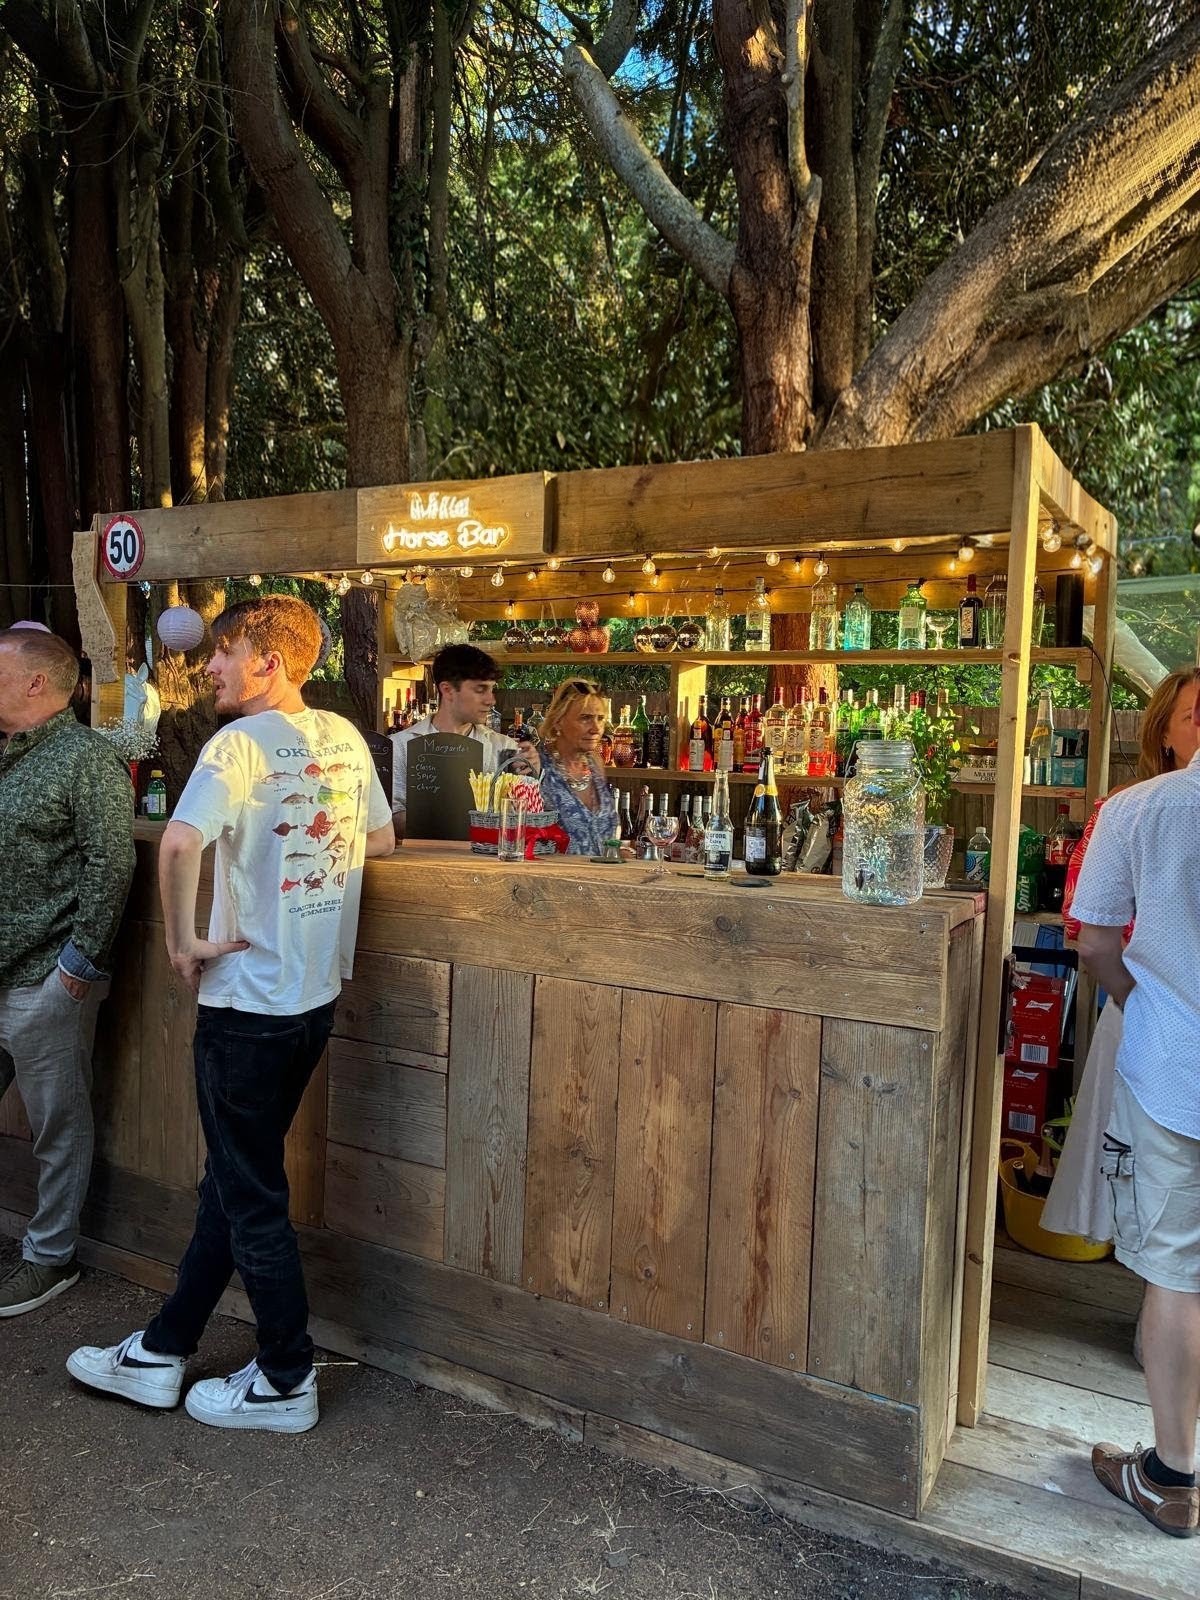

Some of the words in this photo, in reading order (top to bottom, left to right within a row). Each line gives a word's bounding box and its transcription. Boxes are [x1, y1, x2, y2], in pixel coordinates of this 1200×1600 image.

[110, 529, 137, 565] 50
[383, 523, 449, 550] Horse
[457, 520, 504, 548] Bar
[275, 742, 354, 759] OKINAWA
[1016, 875, 1030, 912] Sprite
